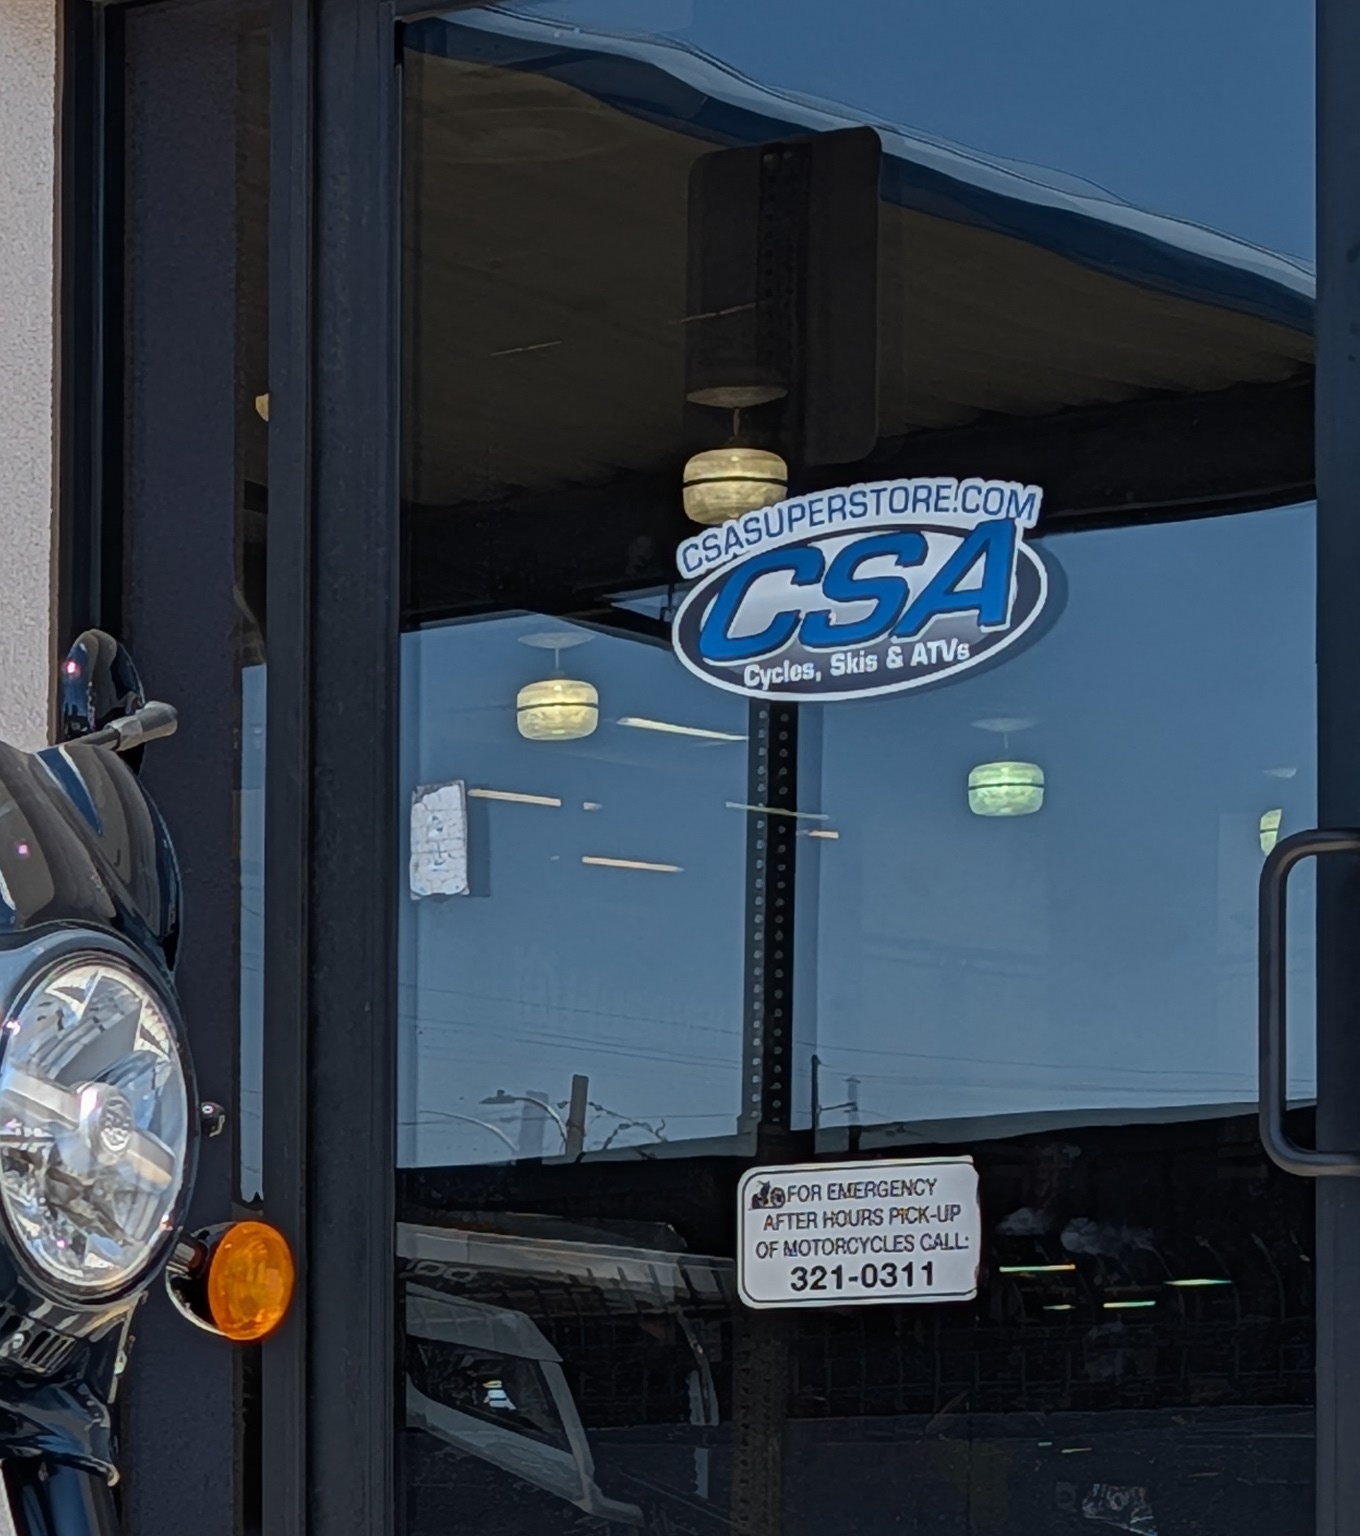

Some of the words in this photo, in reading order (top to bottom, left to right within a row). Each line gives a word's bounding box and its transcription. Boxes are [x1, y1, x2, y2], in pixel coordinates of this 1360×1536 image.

[681, 484, 1037, 573] CSASUPERSTORE.COM
[698, 517, 1017, 661] CSA
[743, 660, 822, 691] Cycles,
[830, 649, 878, 676] Skis
[886, 644, 904, 670] &
[911, 637, 971, 666] ATVs
[787, 1184, 822, 1203] FOR
[827, 1178, 938, 1201] EMERGENCY
[763, 1212, 818, 1231] AFTER
[823, 1208, 884, 1229] HOURS
[889, 1204, 962, 1226] PICK-UP
[755, 1241, 779, 1259] OF
[783, 1234, 916, 1258] MOTORCYCLES
[920, 1231, 970, 1251] CALL:
[790, 1261, 934, 1291] 321-0311
